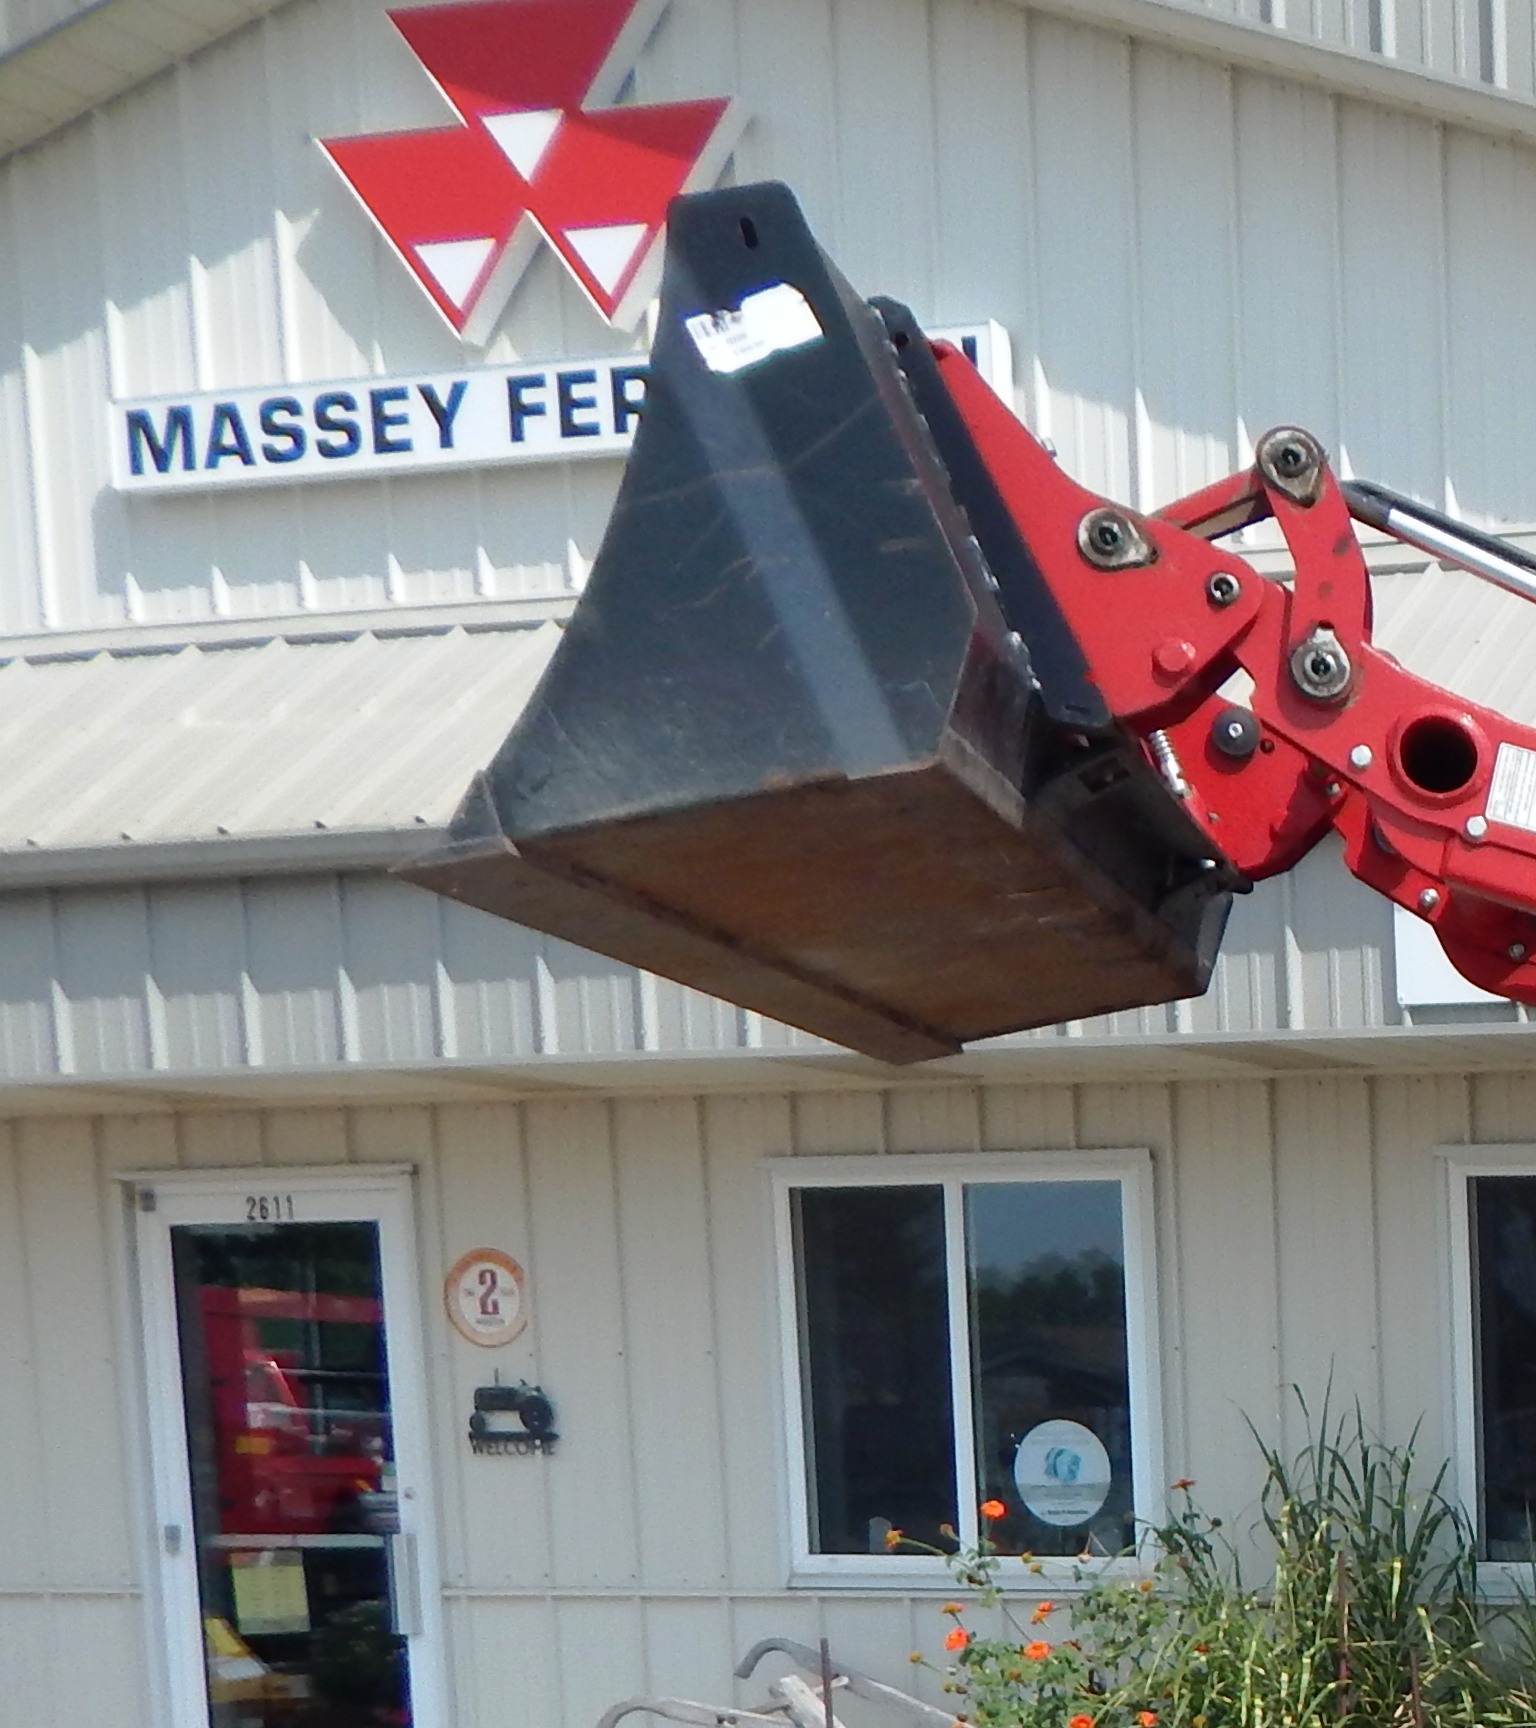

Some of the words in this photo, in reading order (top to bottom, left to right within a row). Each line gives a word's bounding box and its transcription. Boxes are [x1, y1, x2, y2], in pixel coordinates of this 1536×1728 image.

[125, 380, 468, 475] MASSEY
[245, 1195, 295, 1221] 2611
[478, 1268, 500, 1316] 2
[469, 1437, 556, 1457] WELCOME
